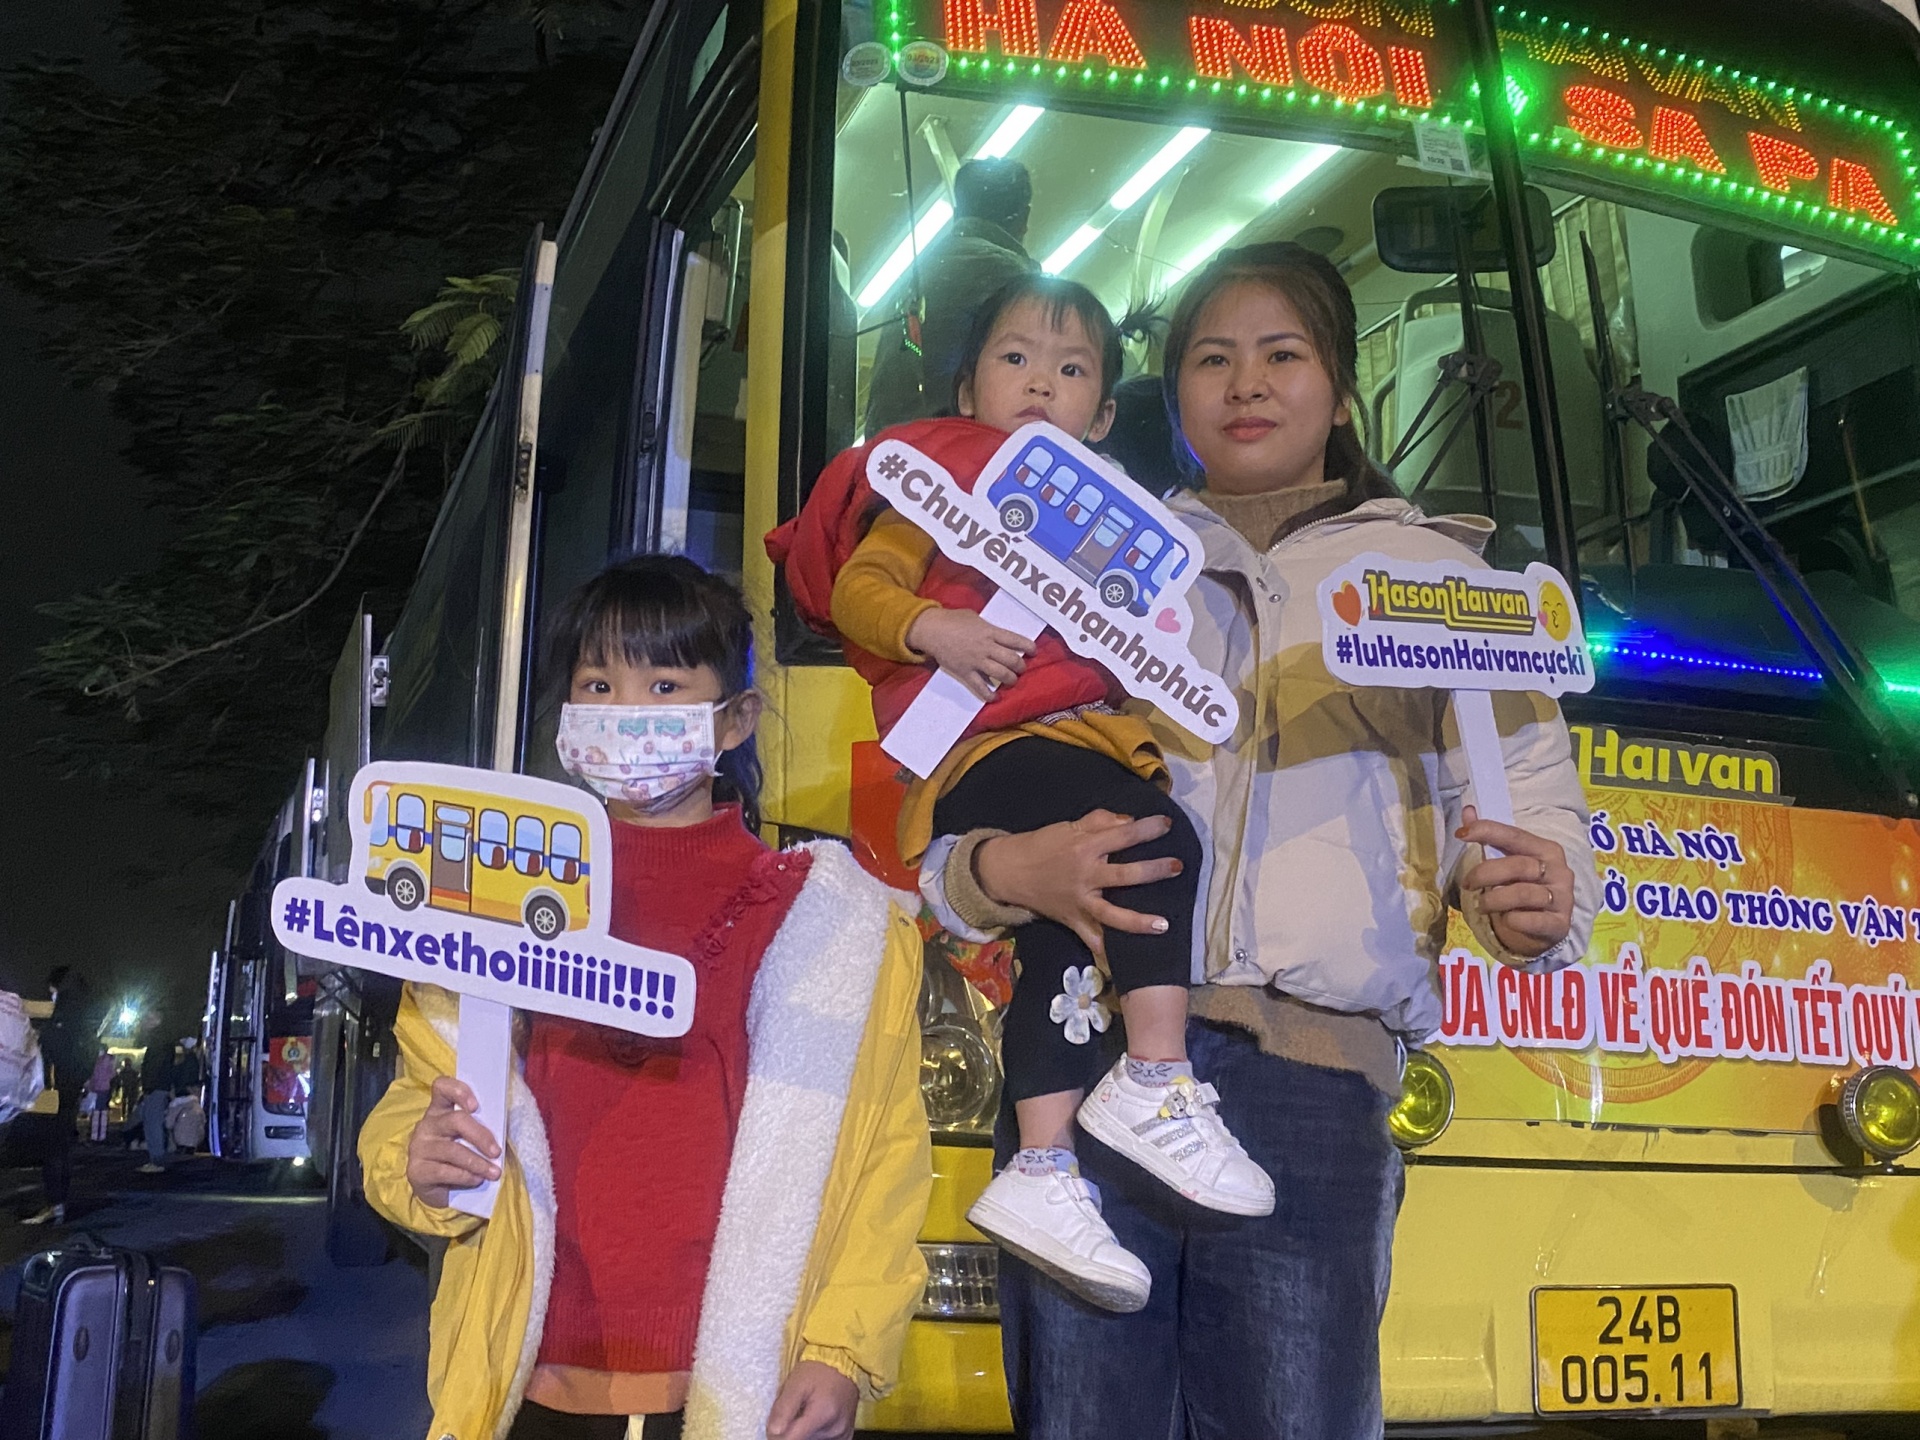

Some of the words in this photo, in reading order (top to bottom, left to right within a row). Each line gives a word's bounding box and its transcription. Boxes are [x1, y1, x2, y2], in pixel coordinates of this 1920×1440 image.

[876, 453, 1228, 728] #Chuyếnxehạnhphúc
[1621, 822, 1676, 857] HÀ
[1677, 826, 1743, 869] NỘI
[1636, 884, 1718, 921] GIAO
[1725, 888, 1834, 932] THÔNG
[1840, 897, 1904, 945] VẬN
[1497, 965, 1587, 1041] CNLĐ
[1599, 951, 1641, 1044] VỀ
[1649, 965, 1714, 1056] QUÊ
[1721, 968, 1786, 1055] ĐÓN
[1792, 966, 1843, 1058] TẾT
[1853, 981, 1908, 1066] QUÝ
[1597, 1295, 1681, 1345] 24B
[1561, 1352, 1713, 1404] 005.11
